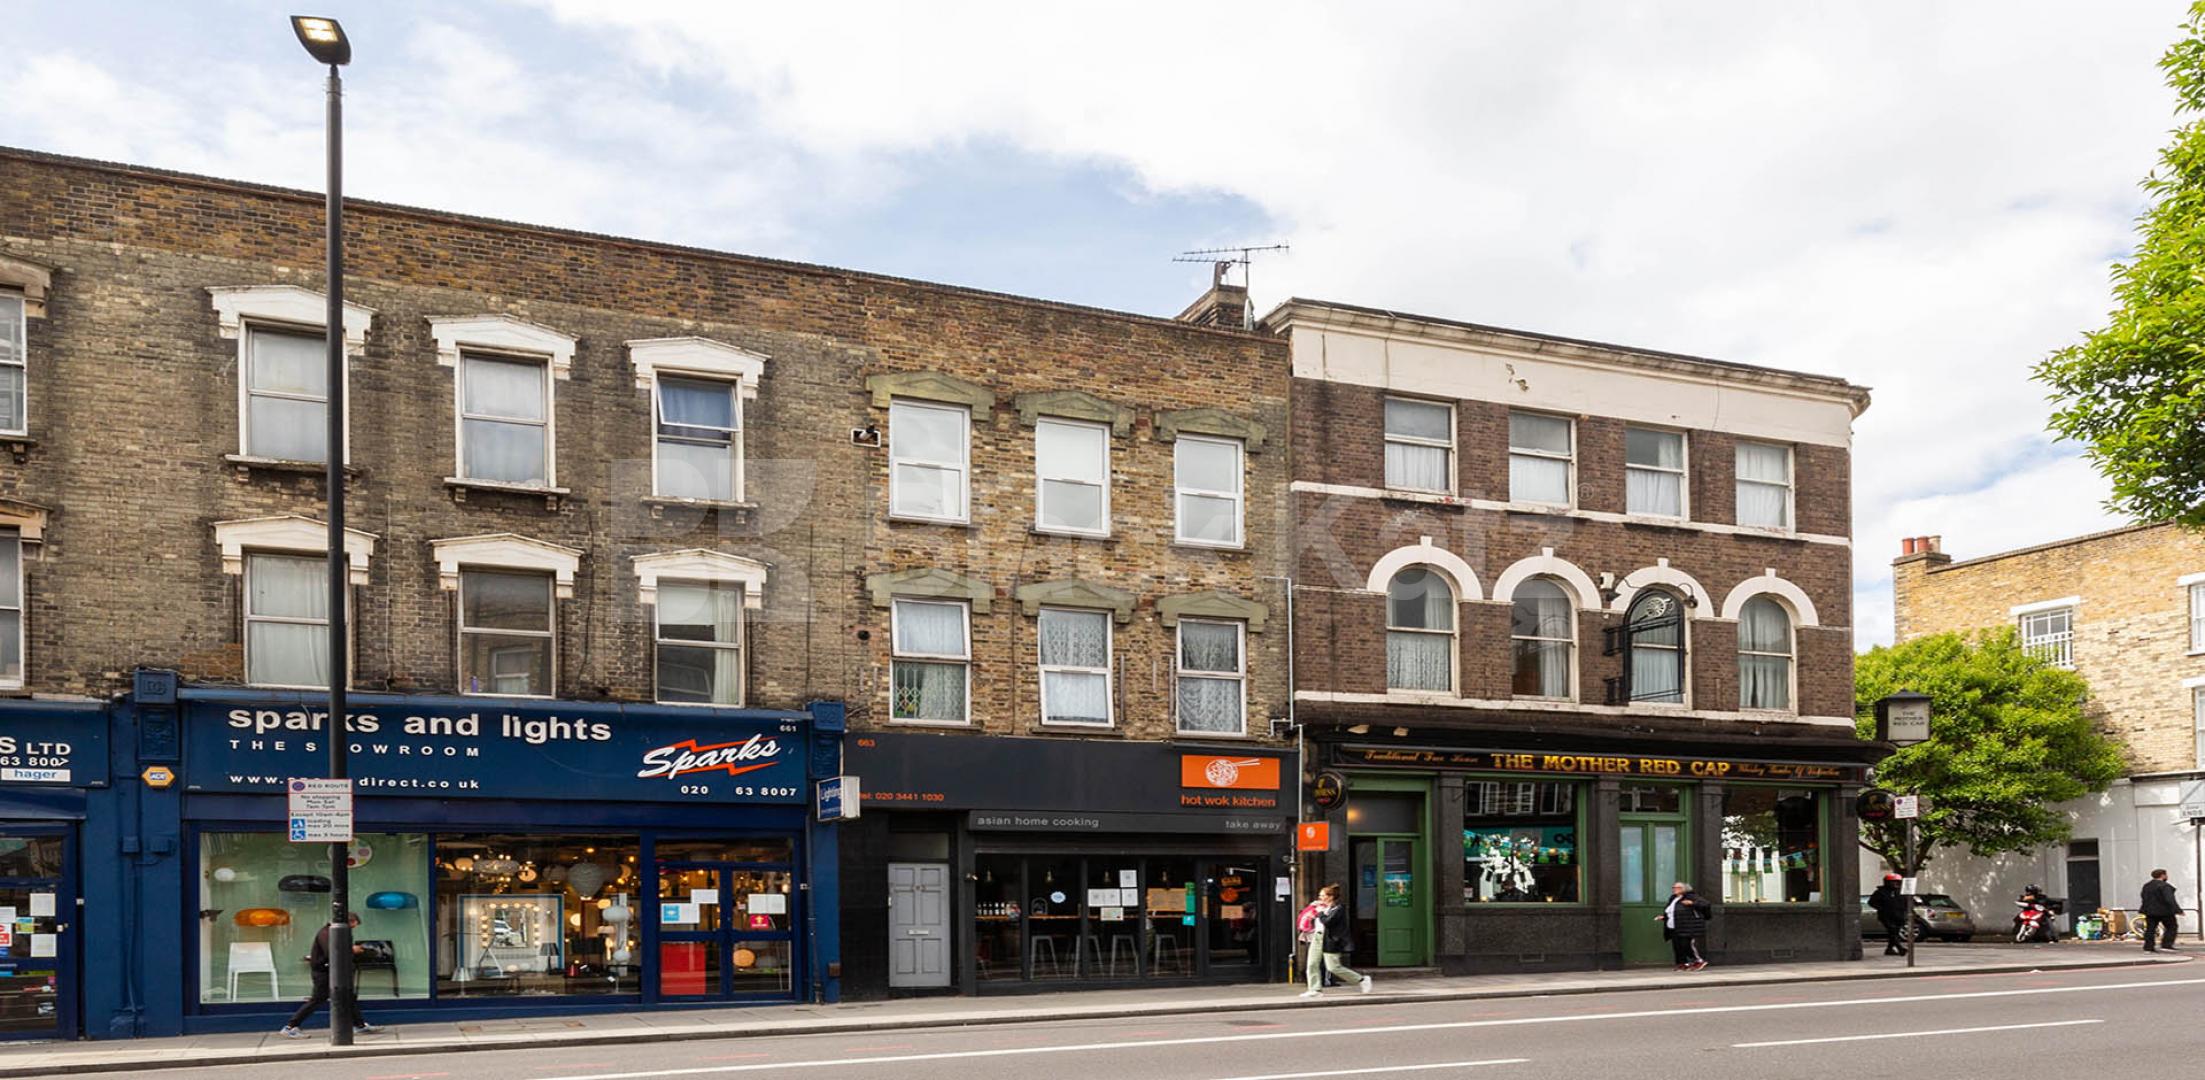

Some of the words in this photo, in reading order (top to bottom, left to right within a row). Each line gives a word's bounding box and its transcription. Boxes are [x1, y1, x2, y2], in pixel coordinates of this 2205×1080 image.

[404, 713, 480, 736] and
[502, 714, 613, 745] lights
[26, 743, 72, 756] LTD
[229, 739, 287, 752] THE
[305, 742, 480, 758] SOWROOM
[637, 733, 782, 780] Sparks
[1491, 752, 1534, 770] THE
[1543, 754, 1631, 774] MOTHER
[1640, 758, 1681, 775] RED
[1690, 760, 1732, 777] CAP
[14, 769, 57, 780] hager
[681, 785, 710, 795] 020
[735, 786, 754, 796] 63
[760, 786, 798, 797] 8007
[875, 793, 893, 801] 020
[1181, 794, 1201, 806] hot
[1204, 796, 1230, 806] wok
[1232, 796, 1276, 808] kitchen
[977, 816, 1012, 826] asian
[1015, 816, 1049, 827] home
[1052, 817, 1100, 829] cooking
[1226, 819, 1249, 829] take
[1252, 822, 1281, 831] away
